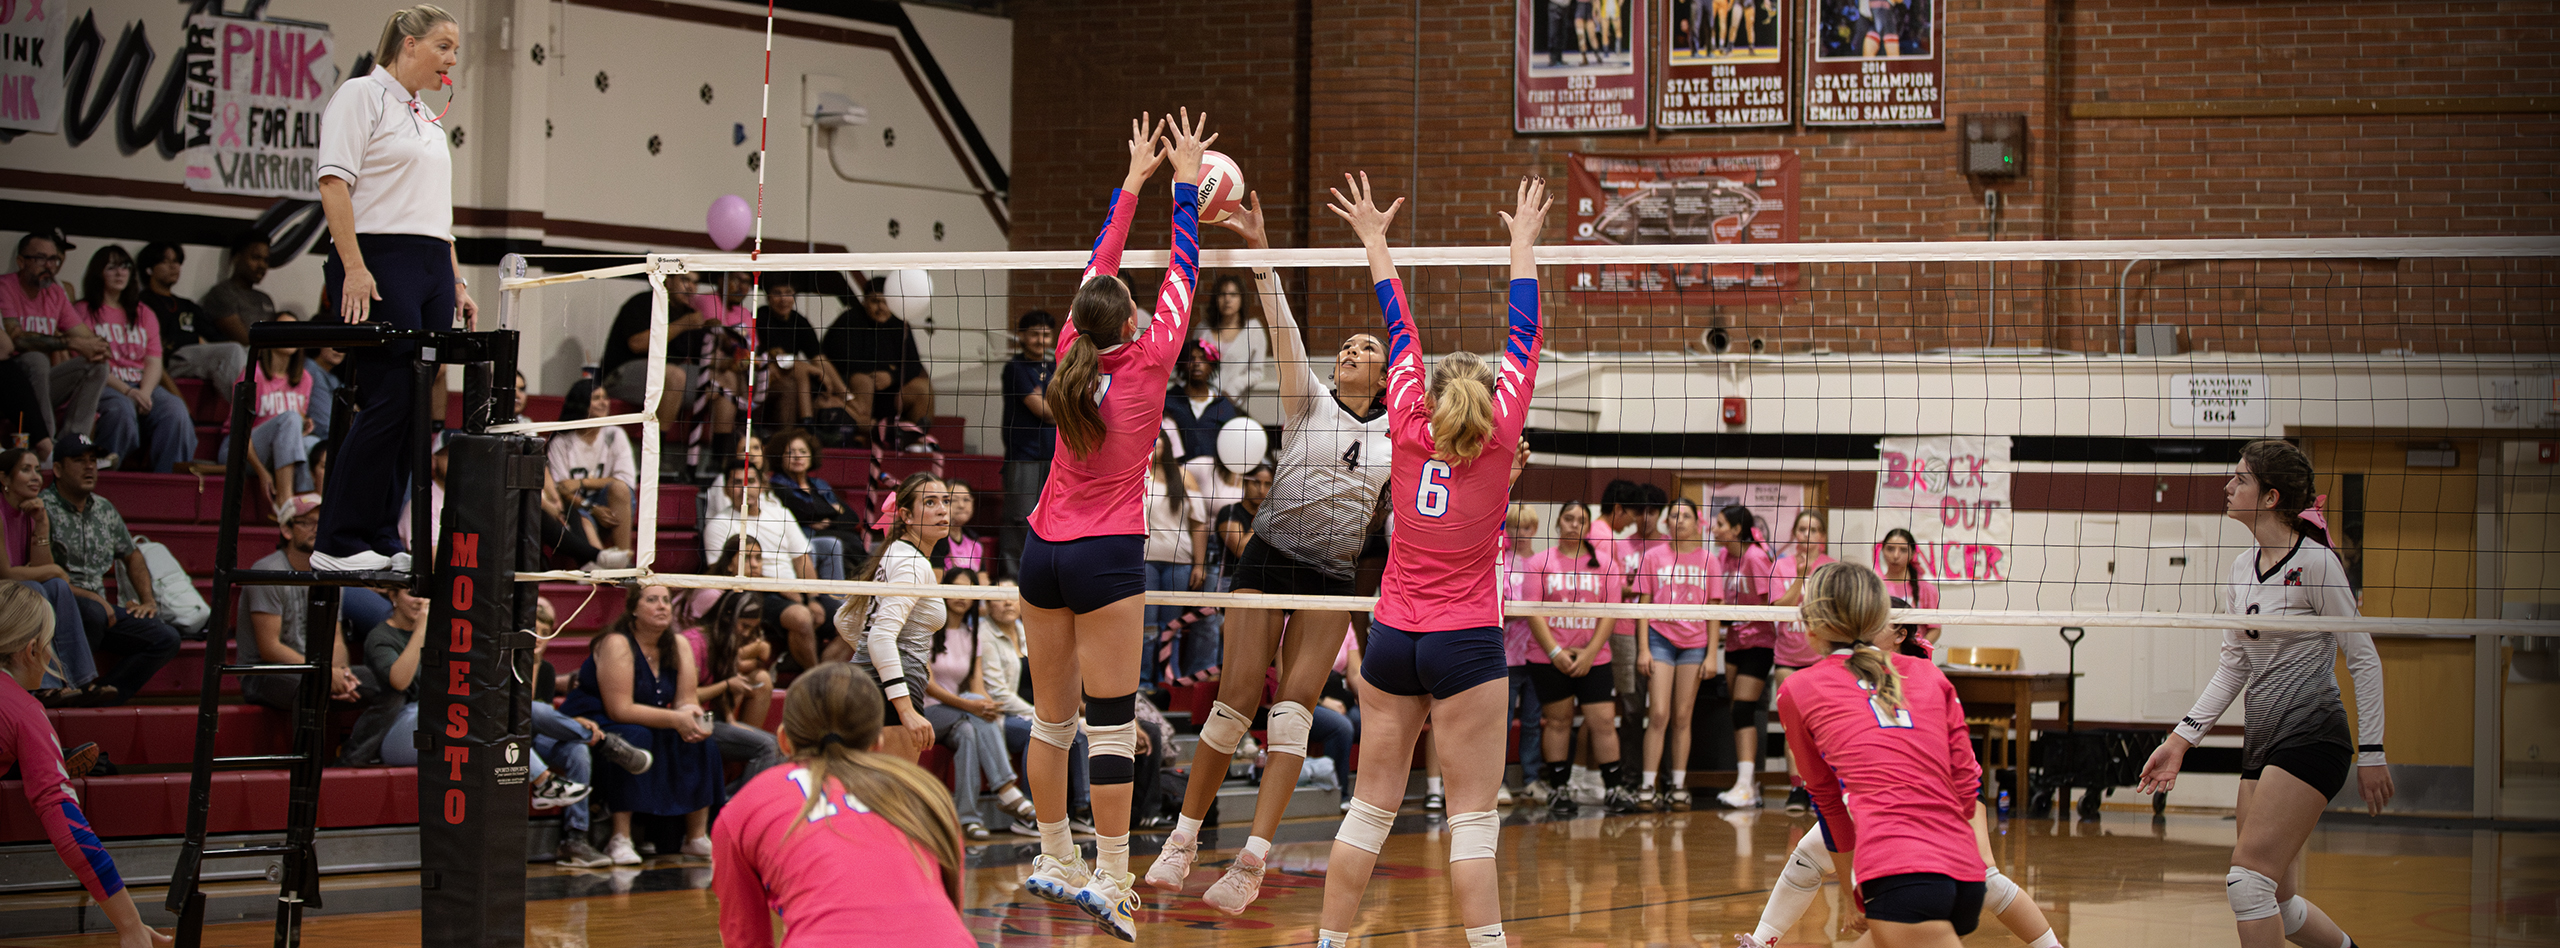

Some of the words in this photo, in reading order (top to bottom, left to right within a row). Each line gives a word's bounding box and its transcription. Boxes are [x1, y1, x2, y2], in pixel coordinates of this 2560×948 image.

[222, 23, 327, 100] PINK
[186, 23, 216, 147] WEAR
[1667, 78, 1709, 93] STATE
[1713, 75, 1782, 91] CHAMPION
[1815, 73, 1859, 89] STATE
[1863, 72, 1934, 88] CHAMPION
[1688, 91, 1740, 107] WEIGHT
[1744, 90, 1784, 105] CLASS
[1837, 88, 1891, 103] WEIGHT
[1895, 87, 1938, 102] CLASS
[1661, 109, 1711, 125] ISRAEL
[1715, 107, 1784, 123] SAAVEDRA
[1809, 105, 1859, 120] EMILIO
[1863, 104, 1933, 120] SAAVEDRA
[247, 106, 287, 148] FOR
[292, 111, 320, 148] ALL
[214, 152, 320, 192] WARRIOR
[1579, 197, 1593, 213] R
[1577, 272, 1592, 287] R
[19, 316, 57, 336] OHI
[2188, 379, 2252, 387] MAXIMUM
[2190, 389, 2248, 397] BLEACHER
[2191, 398, 2248, 407] CAPACITY
[2203, 410, 2236, 423] 864
[1341, 439, 1362, 473] 4
[1415, 458, 1451, 518] 6
[1940, 496, 2000, 530] OUT
[1873, 541, 2004, 580] CNCER
[1547, 572, 1600, 595] MOHI
[444, 532, 479, 825] MODESTO
